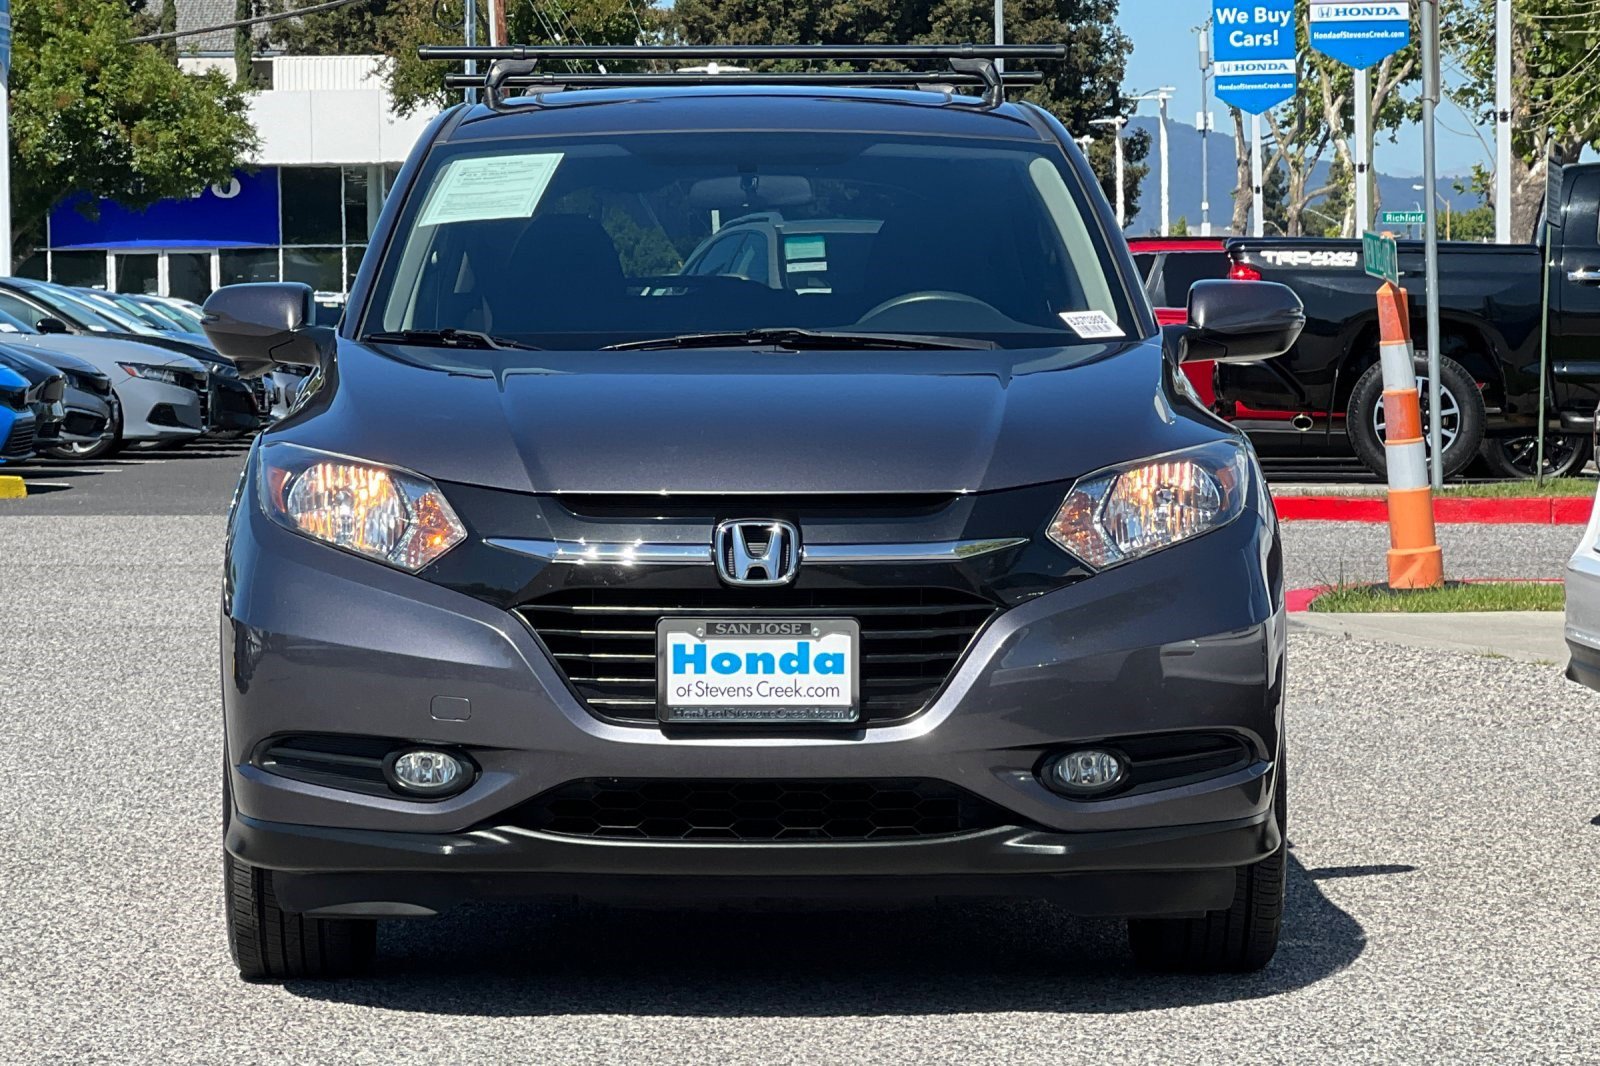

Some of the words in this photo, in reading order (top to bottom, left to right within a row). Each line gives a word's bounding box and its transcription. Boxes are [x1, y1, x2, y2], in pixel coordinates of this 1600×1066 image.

[1215, 8, 1249, 24] We
[1254, 7, 1291, 26] Buy
[1334, 6, 1400, 17] HONDA
[1229, 29, 1279, 47] Cars!
[1313, 30, 1405, 40] HondaofStevensCreek.com
[1234, 62, 1289, 71] HONDA
[1386, 213, 1424, 223] Richfield
[715, 623, 751, 635] SAN
[756, 623, 803, 635] JOSE
[673, 641, 845, 675] Honda
[676, 683, 692, 698] of
[695, 680, 753, 698] Stevens
[756, 678, 840, 698] Creek.com
